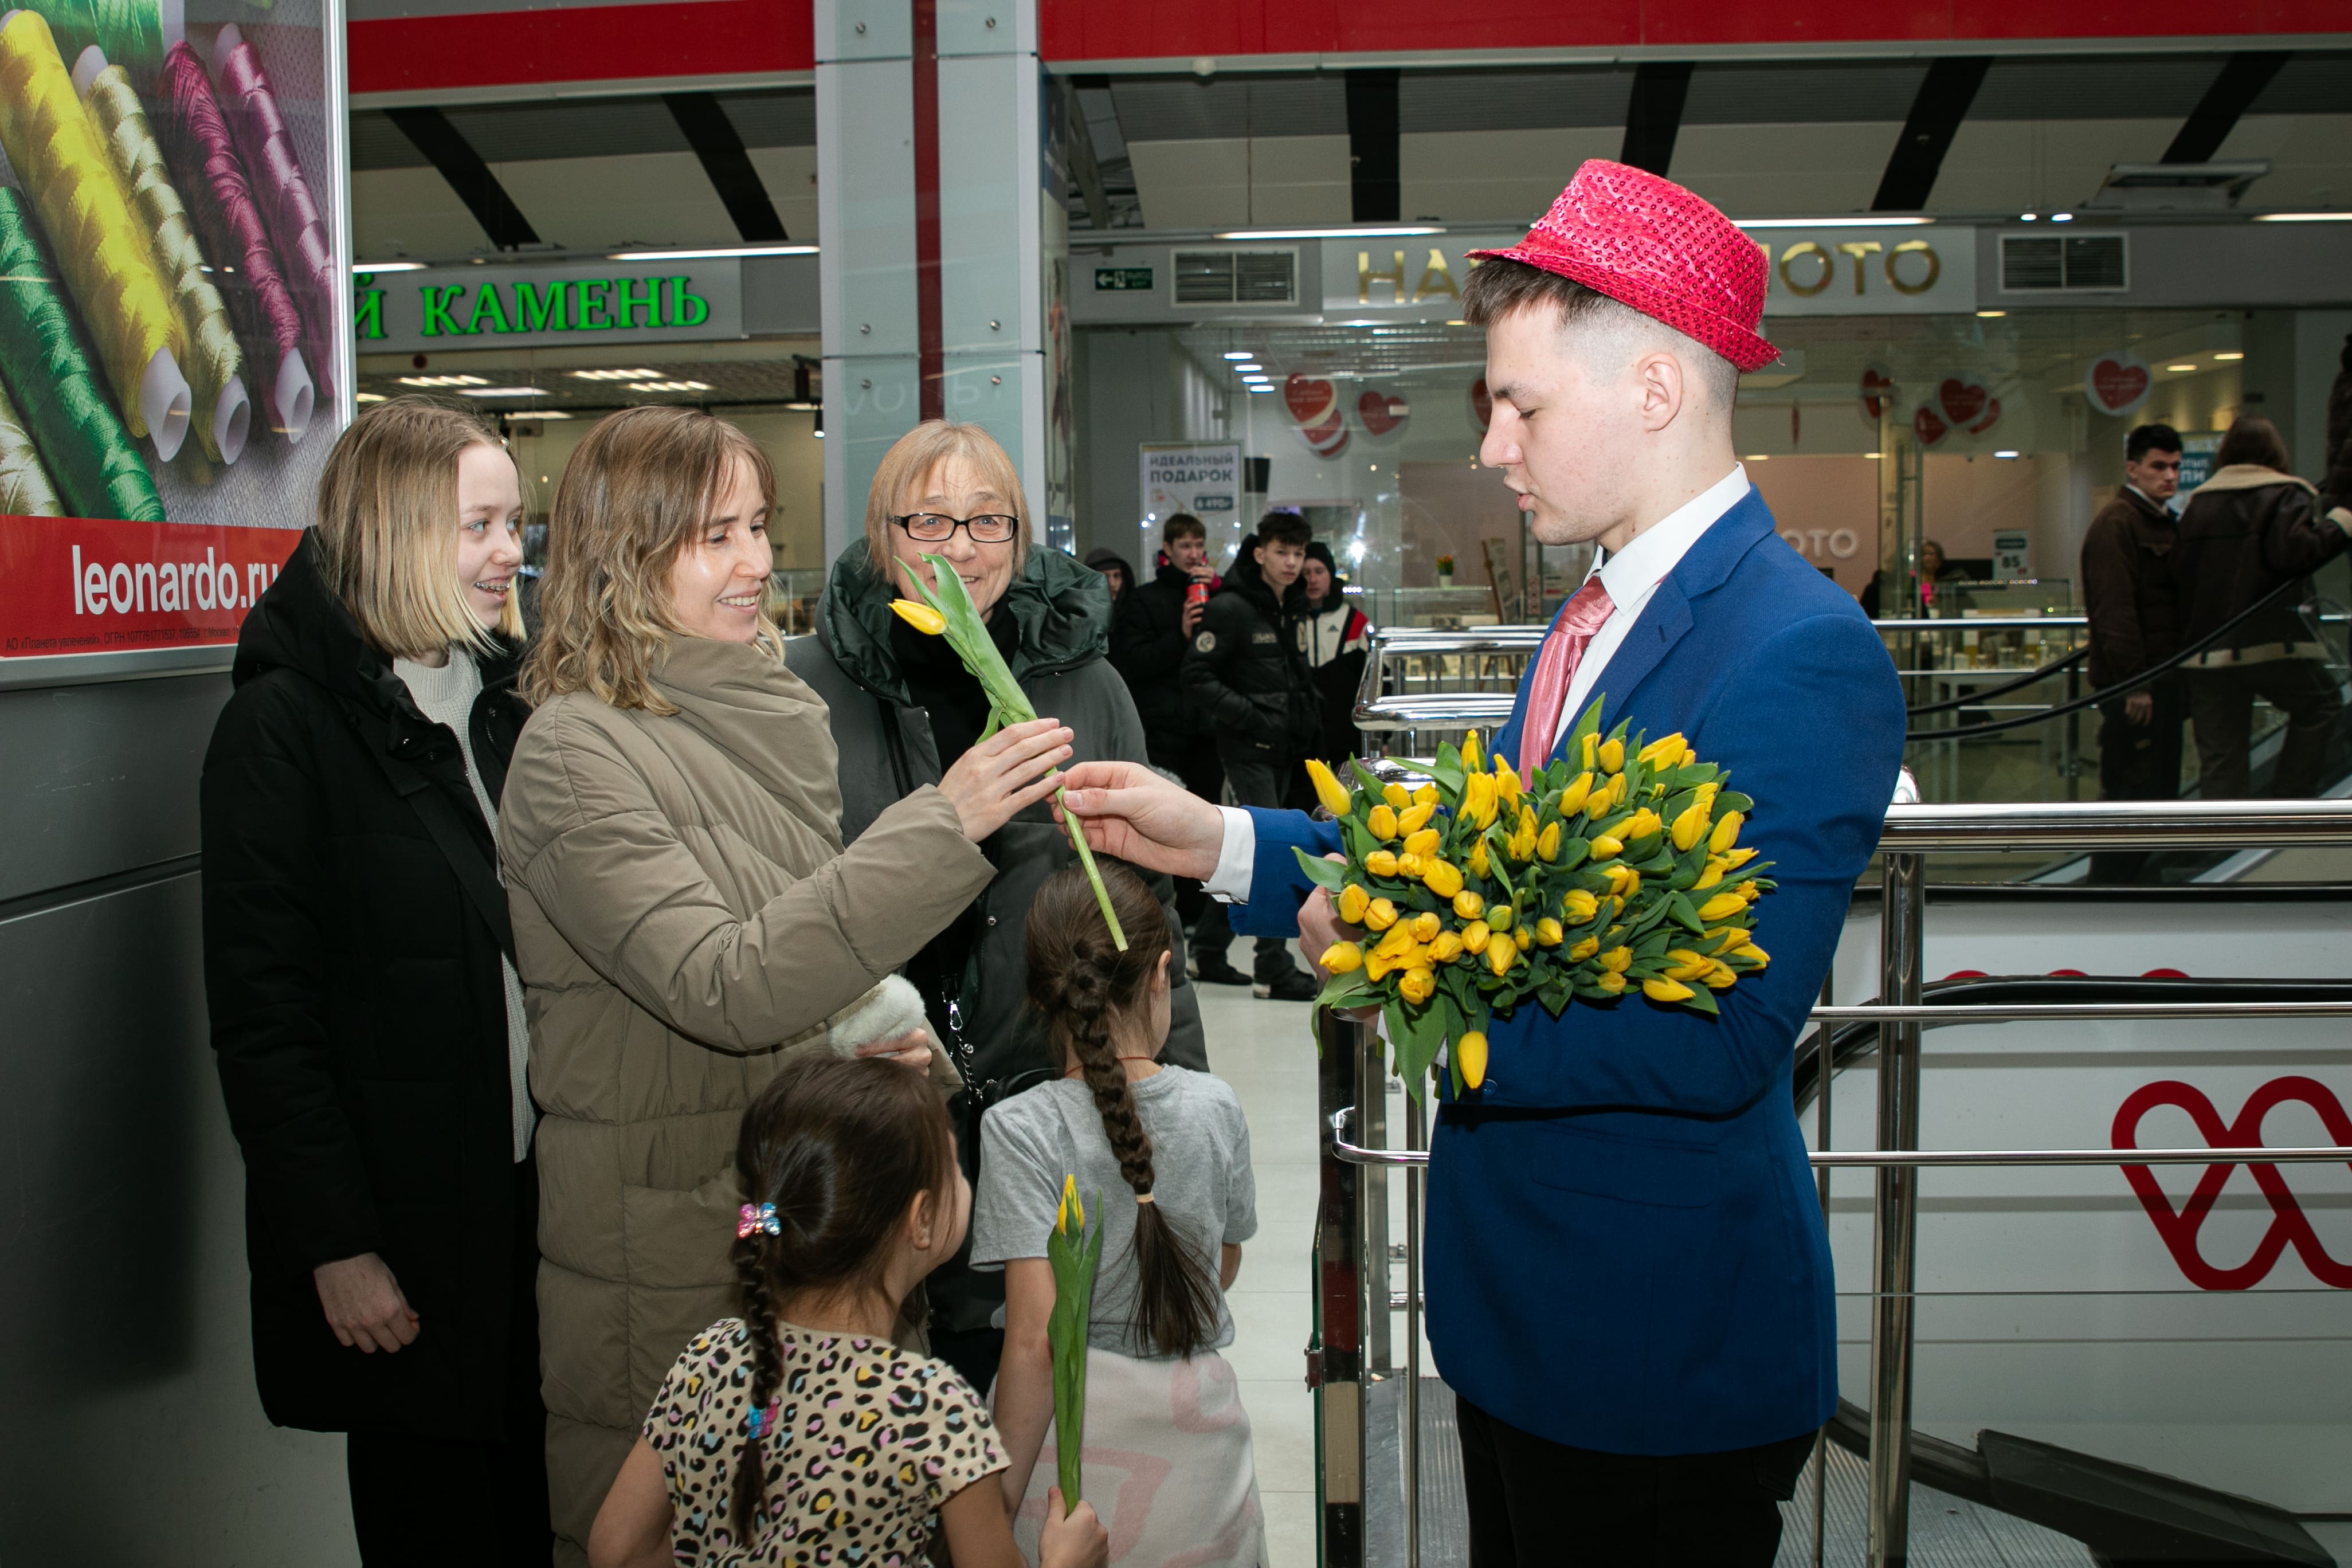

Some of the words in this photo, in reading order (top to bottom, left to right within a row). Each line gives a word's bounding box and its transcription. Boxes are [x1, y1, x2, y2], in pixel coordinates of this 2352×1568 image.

[420, 276, 709, 337] КАМЕНЬ
[1150, 453, 1234, 467] ИДЕАЛЬНЫЙ
[1150, 469, 1232, 483] ПОДАРОК
[6, 637, 18, 650] АО
[21, 636, 57, 649] «Планета
[59, 633, 103, 650] увлечений»,
[104, 632, 126, 644] ОГРН
